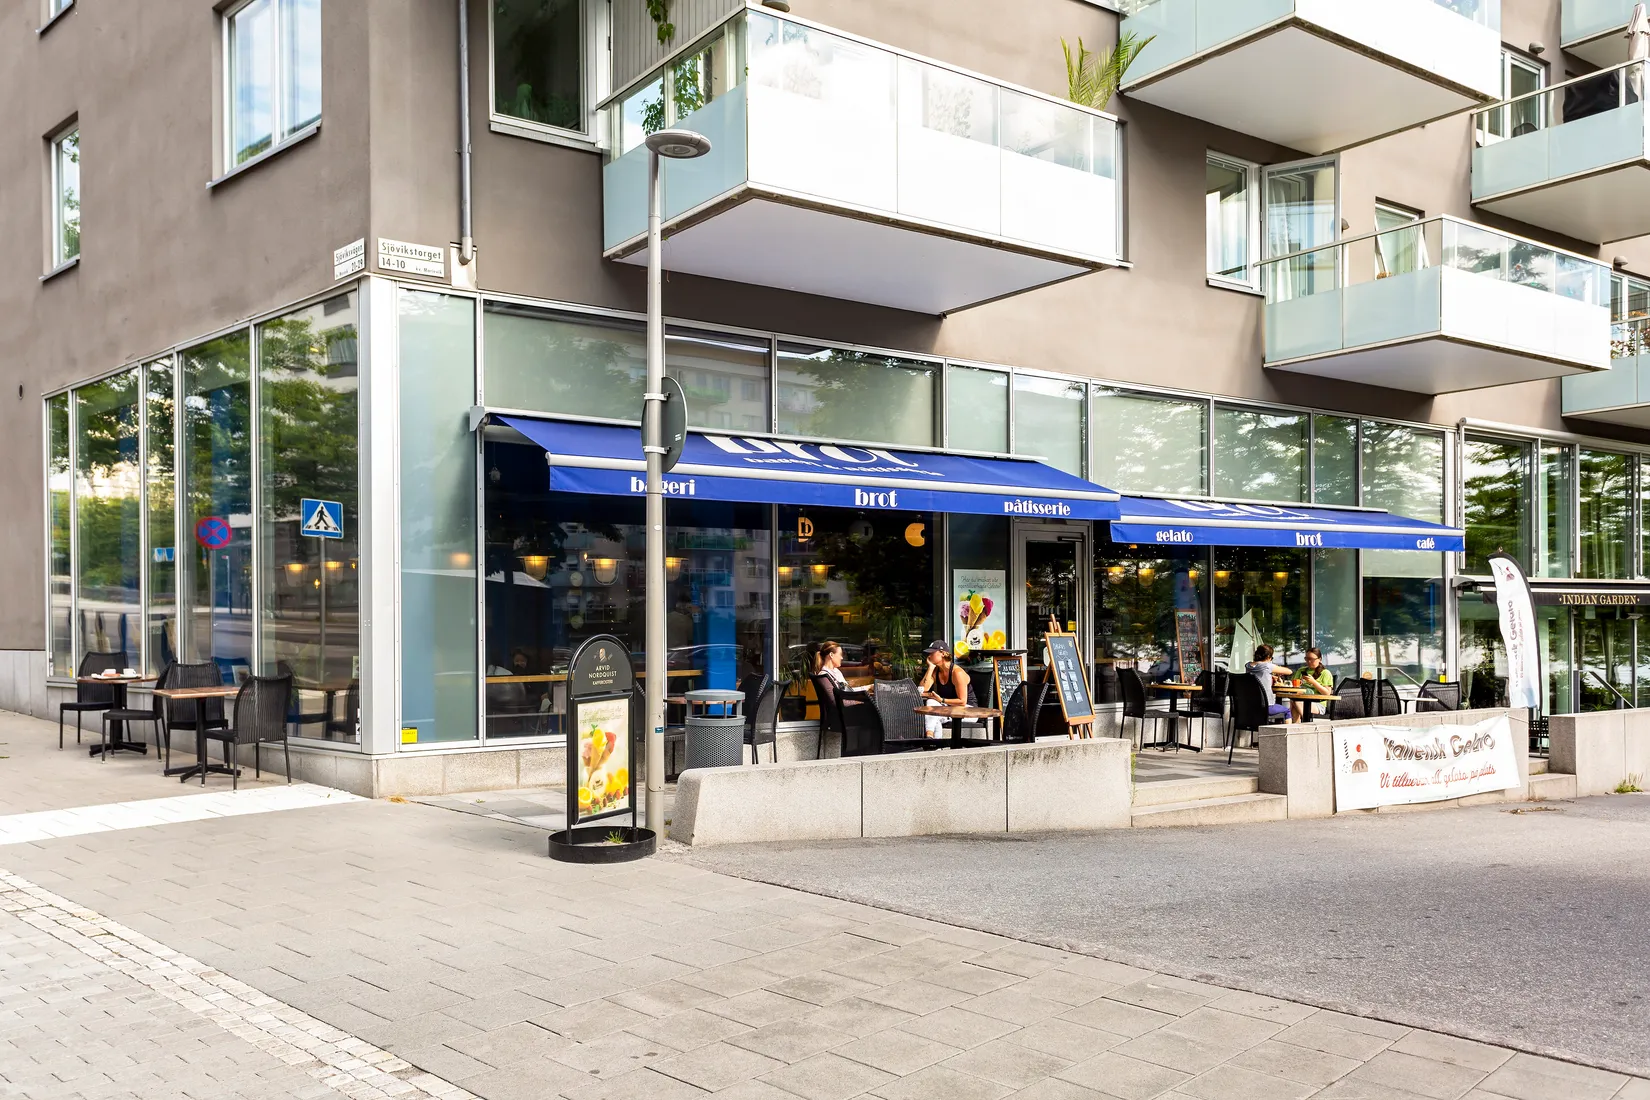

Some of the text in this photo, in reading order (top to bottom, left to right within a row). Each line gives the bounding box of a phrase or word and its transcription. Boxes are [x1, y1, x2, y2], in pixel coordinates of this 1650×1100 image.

[381, 242, 442, 260] Sjövikstorget
[382, 258, 406, 269] 14-10
[630, 476, 695, 496] bgeri
[855, 488, 898, 508] brot
[1004, 499, 1071, 516] pâtisserie
[1156, 529, 1194, 543] gelato
[1295, 532, 1323, 546] brot
[1416, 536, 1435, 549] café
[1562, 594, 1637, 605] INDIAN GARDEN
[588, 671, 617, 679] NORDQUIST
[1379, 772, 1391, 788] Vi
[1443, 766, 1468, 788] gelato
